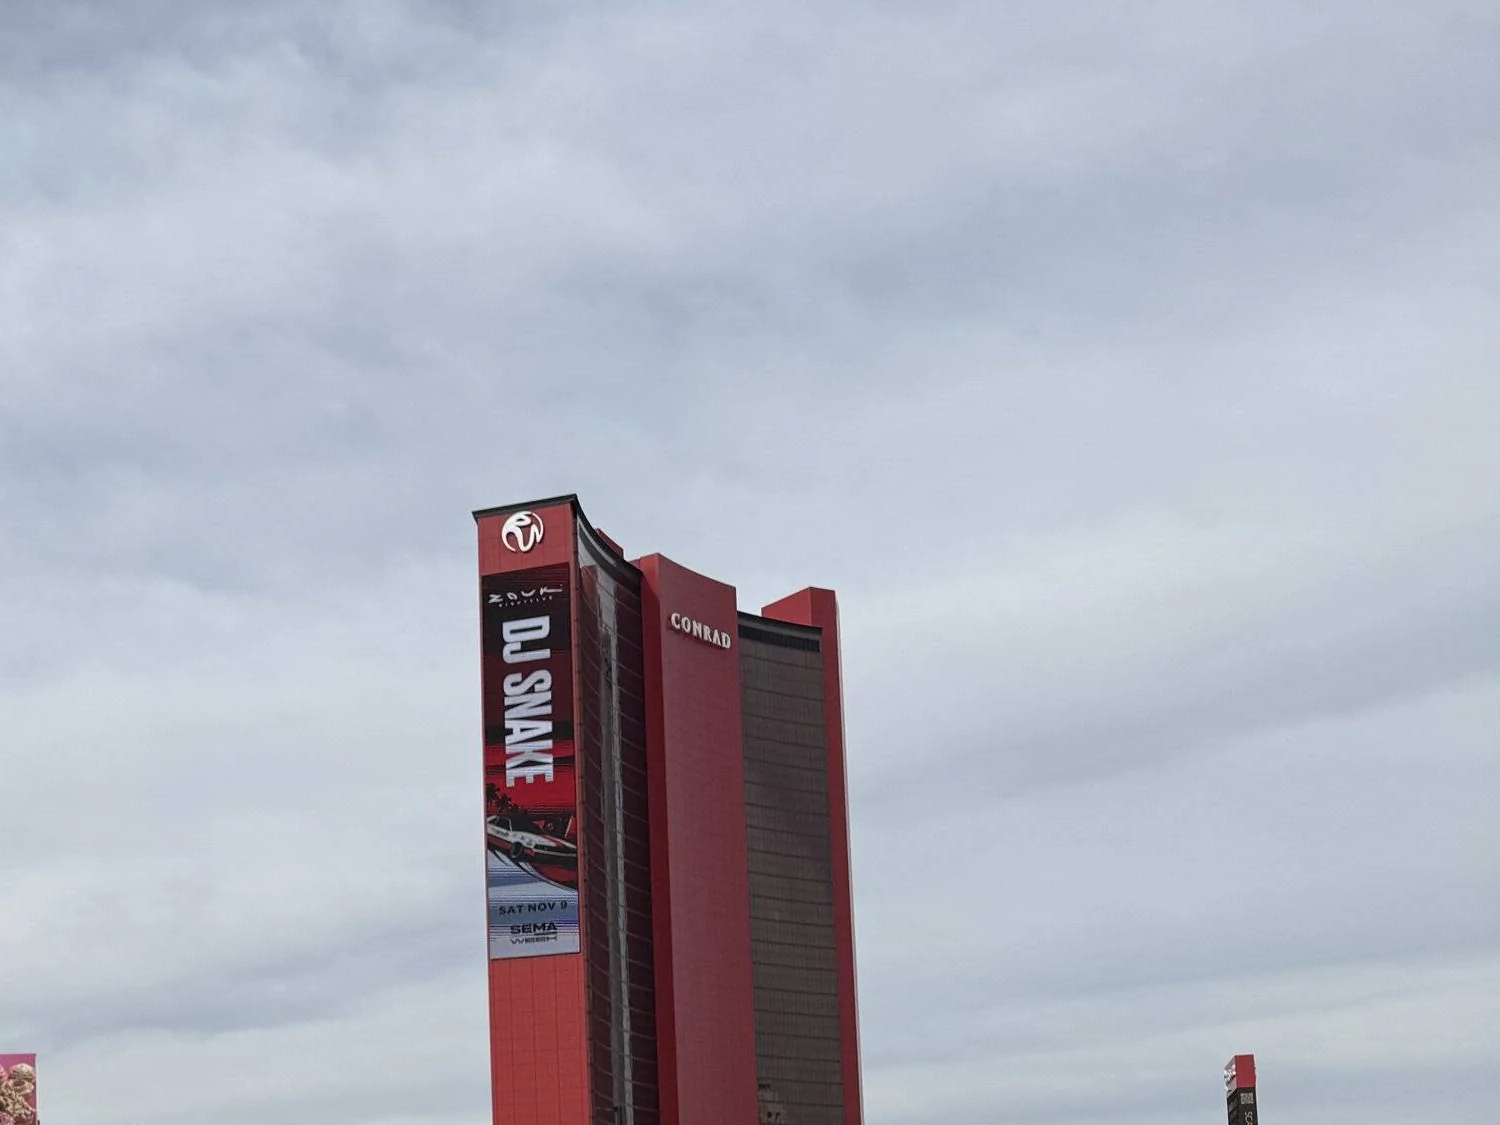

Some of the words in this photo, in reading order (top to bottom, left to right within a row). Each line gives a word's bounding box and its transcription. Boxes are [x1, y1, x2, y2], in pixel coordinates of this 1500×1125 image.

[502, 615, 550, 664] DJ
[671, 612, 731, 649] CONRAD
[503, 669, 554, 788] SNAKE
[499, 904, 522, 915] SAT
[528, 902, 556, 912] NOV
[510, 922, 558, 934] SEMA
